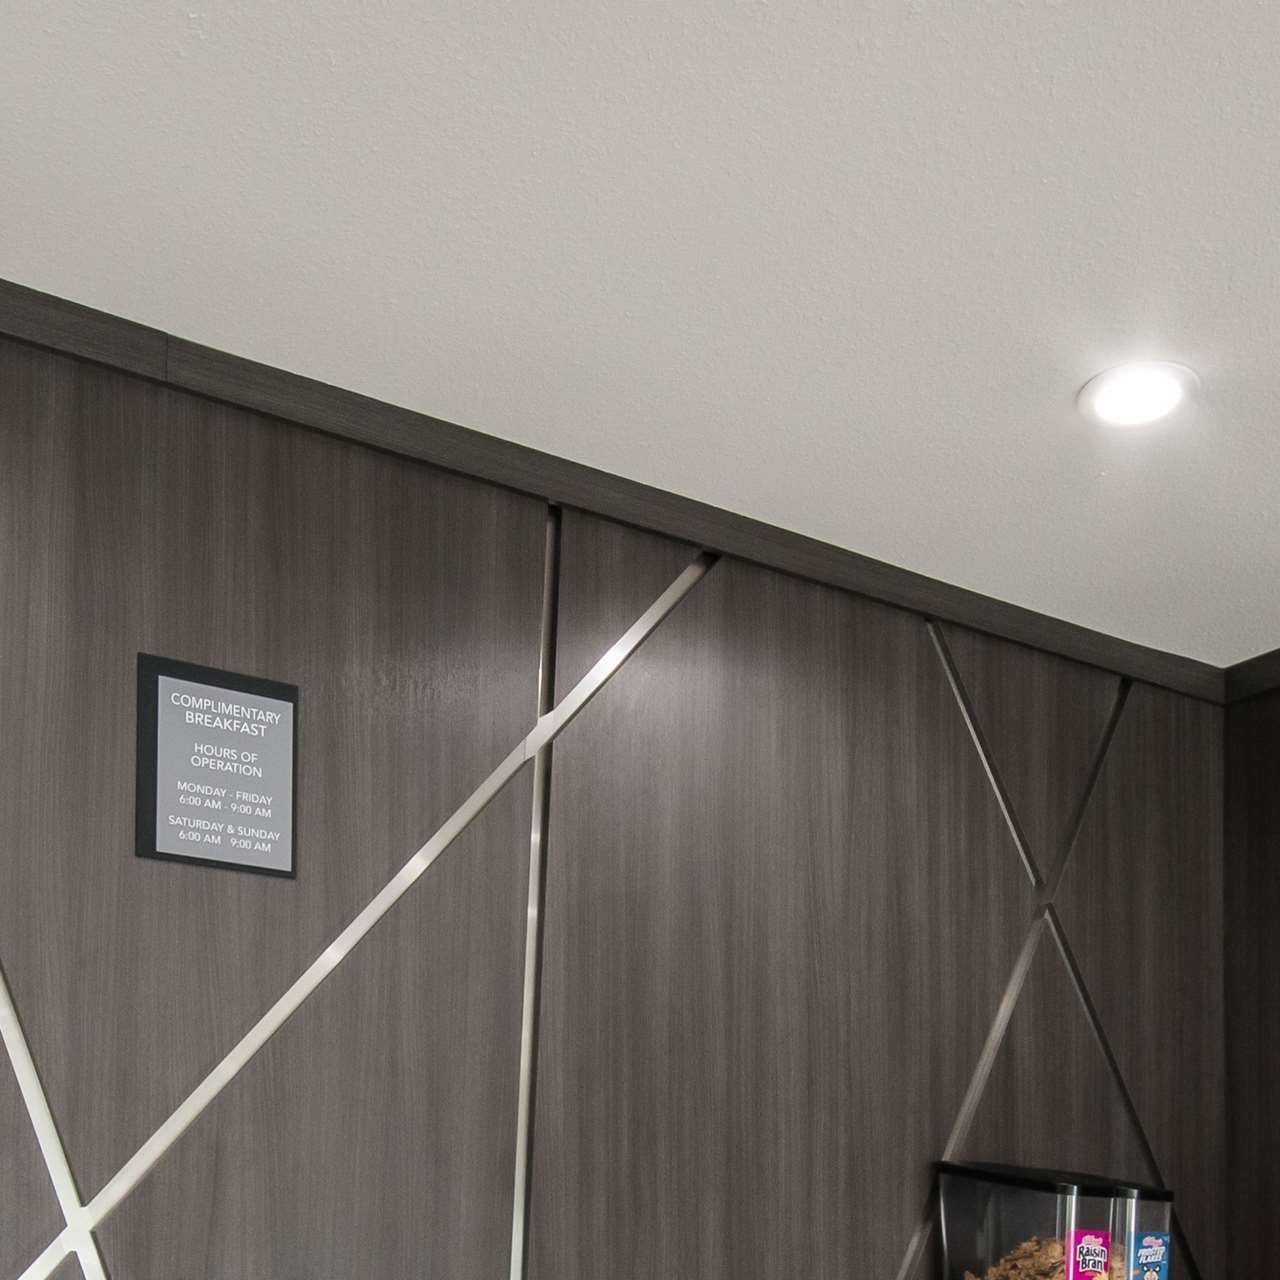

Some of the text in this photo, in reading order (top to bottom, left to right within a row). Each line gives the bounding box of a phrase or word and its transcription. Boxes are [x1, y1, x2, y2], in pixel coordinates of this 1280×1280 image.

[170, 692, 281, 725] COMPLIMENTARY
[185, 710, 267, 737] BREAKFAST
[194, 743, 258, 763] HOURS OF
[191, 755, 262, 778] OPERATION
[177, 781, 227, 798] MONDAY
[236, 791, 273, 806] FRIDAY
[179, 794, 201, 807] 6:00
[204, 798, 222, 809] AM
[230, 803, 252, 815] 9:00
[254, 806, 272, 818] AM
[168, 815, 281, 841] SATURDAY & SUNDAY
[178, 830, 272, 853] 6:00 AM 9:00 AM
[1078, 1245, 1106, 1260] Raisin
[1081, 1258, 1103, 1270] Bran
